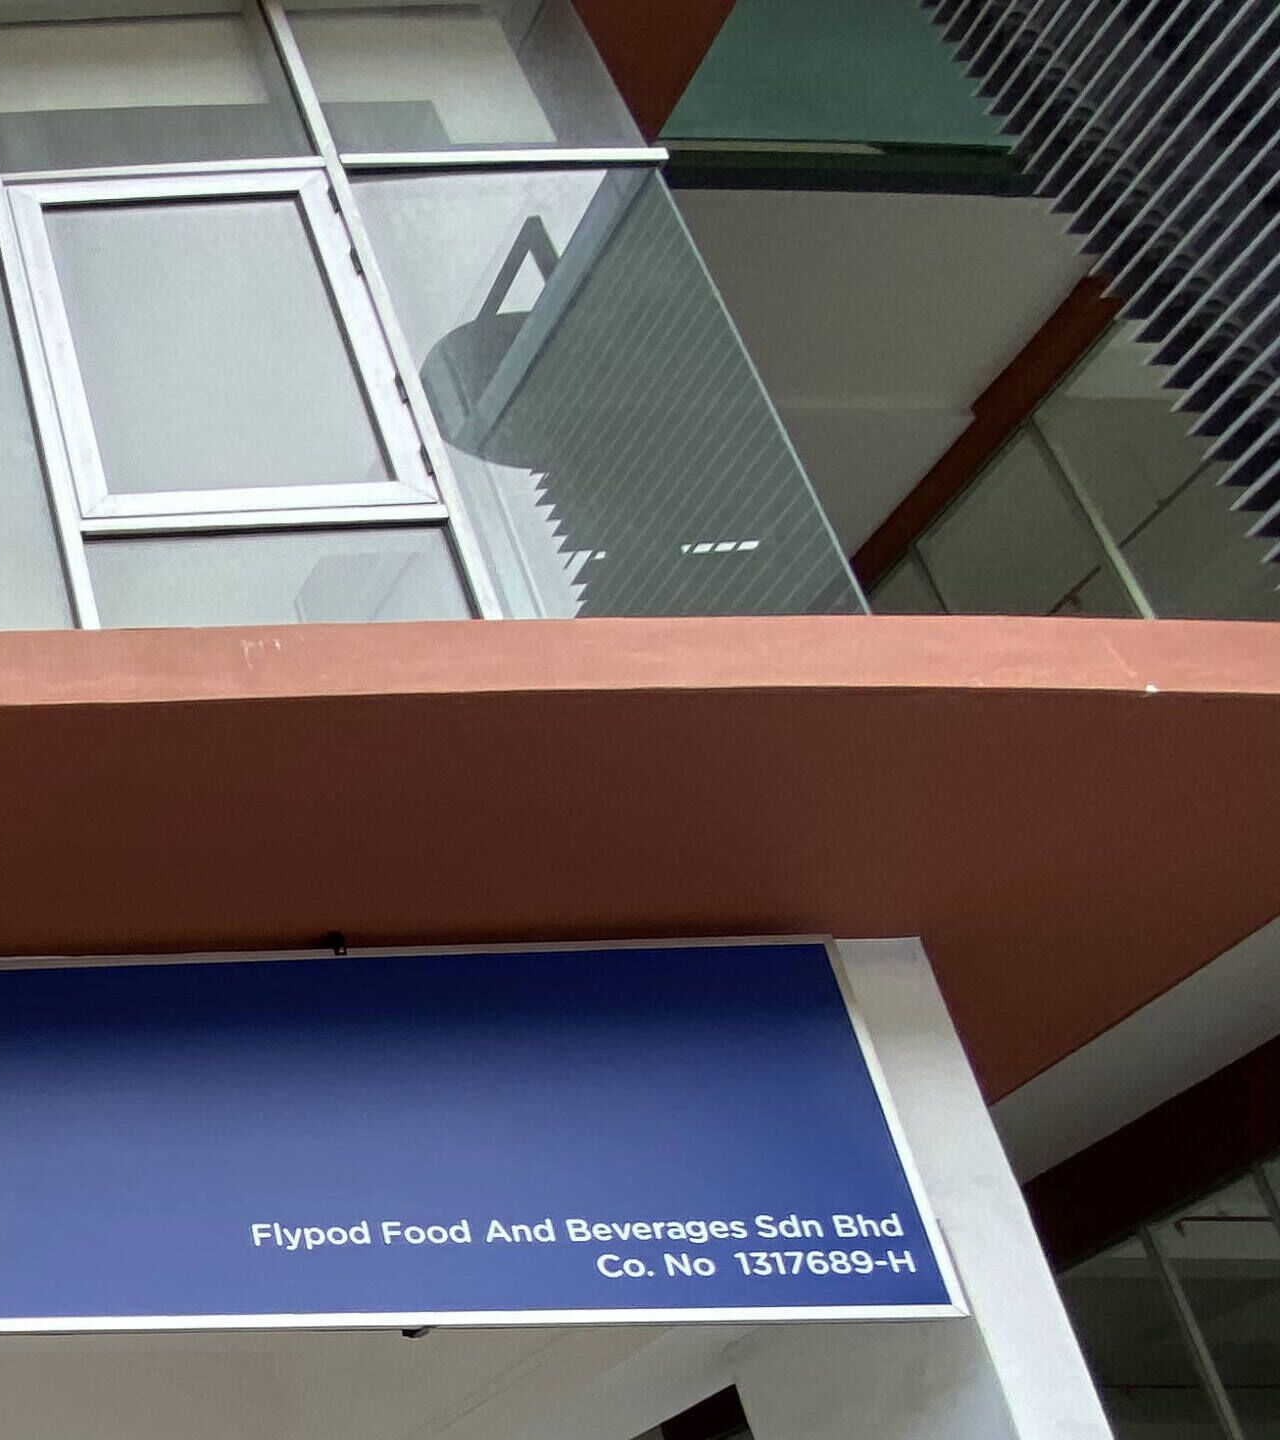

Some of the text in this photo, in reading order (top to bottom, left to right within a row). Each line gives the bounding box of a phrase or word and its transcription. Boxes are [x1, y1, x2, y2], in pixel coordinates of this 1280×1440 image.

[251, 1212, 904, 1250] Flypod Food And Beverages Sdn Bhd
[596, 1249, 917, 1279] Co. No 1317689-H
